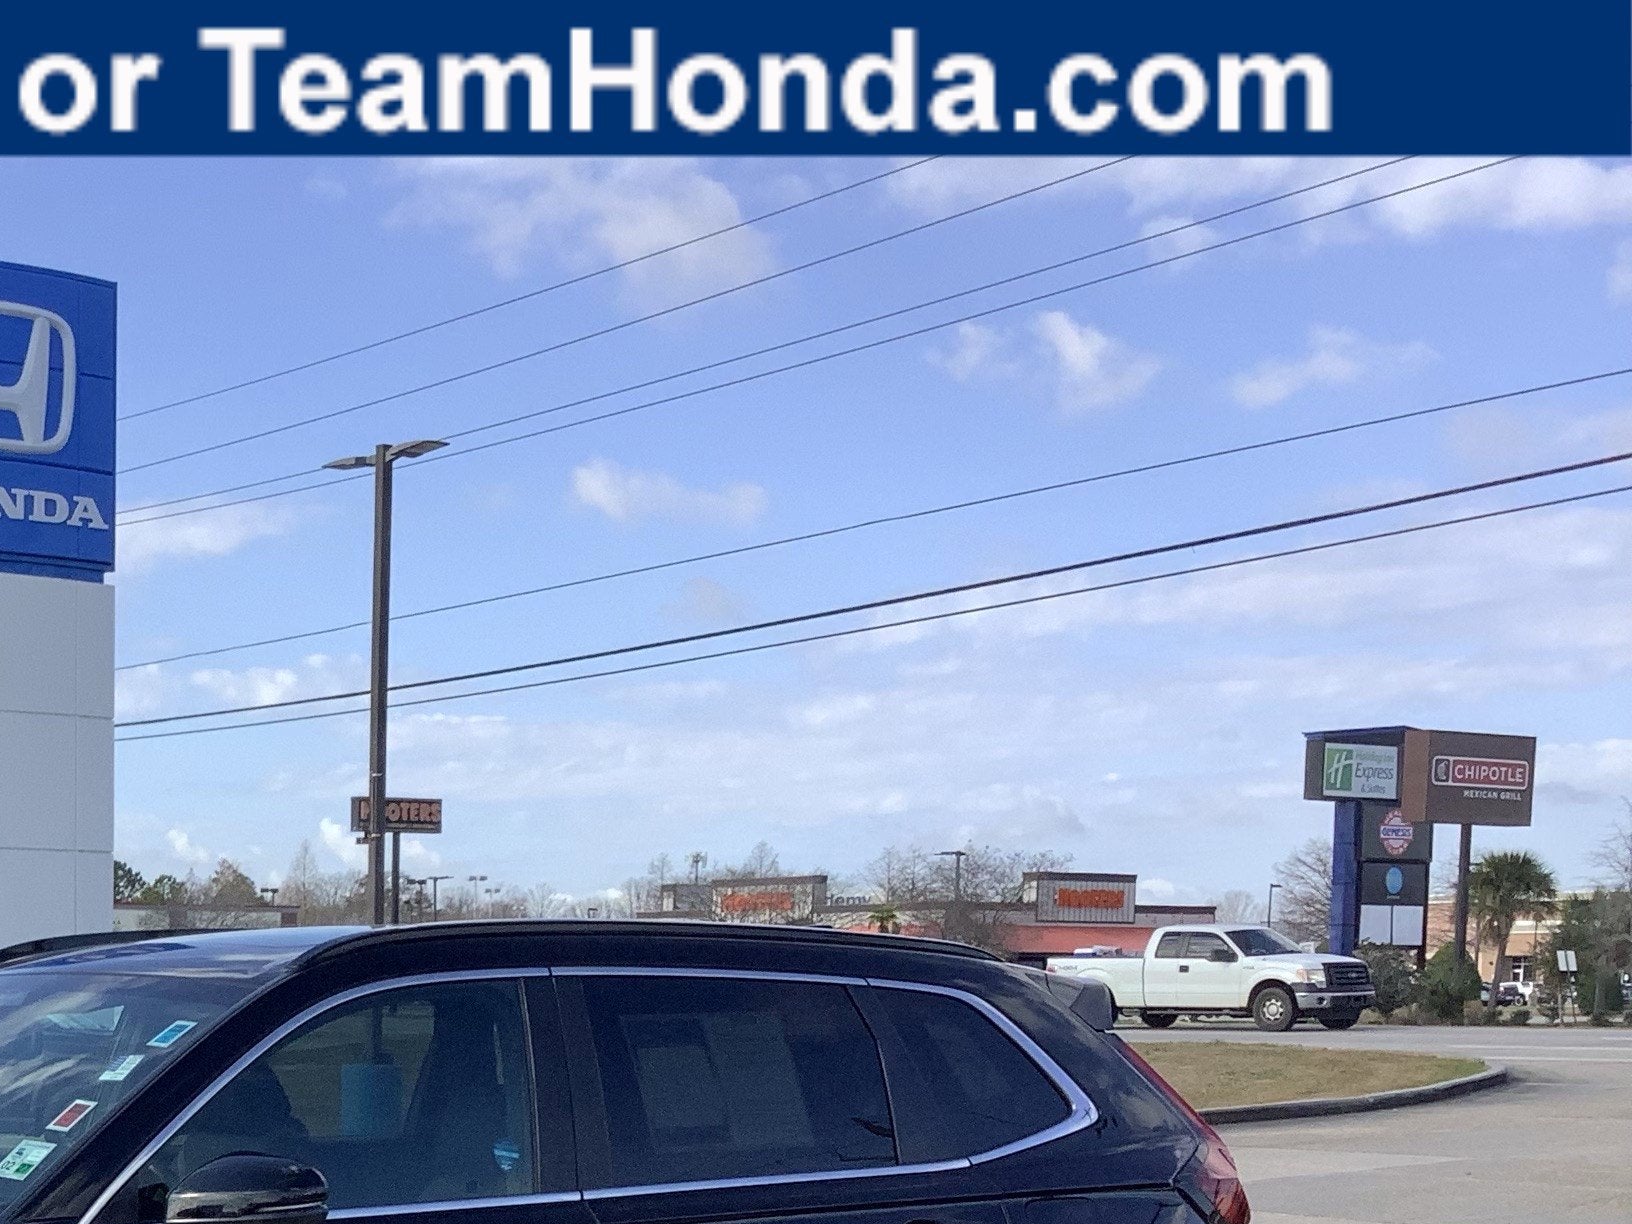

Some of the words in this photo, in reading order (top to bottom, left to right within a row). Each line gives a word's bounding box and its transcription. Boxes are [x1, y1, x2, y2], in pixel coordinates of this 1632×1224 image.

[1355, 762, 1394, 782] Express
[1454, 764, 1524, 783] CHIPOTLE
[360, 801, 440, 822] HOTERS
